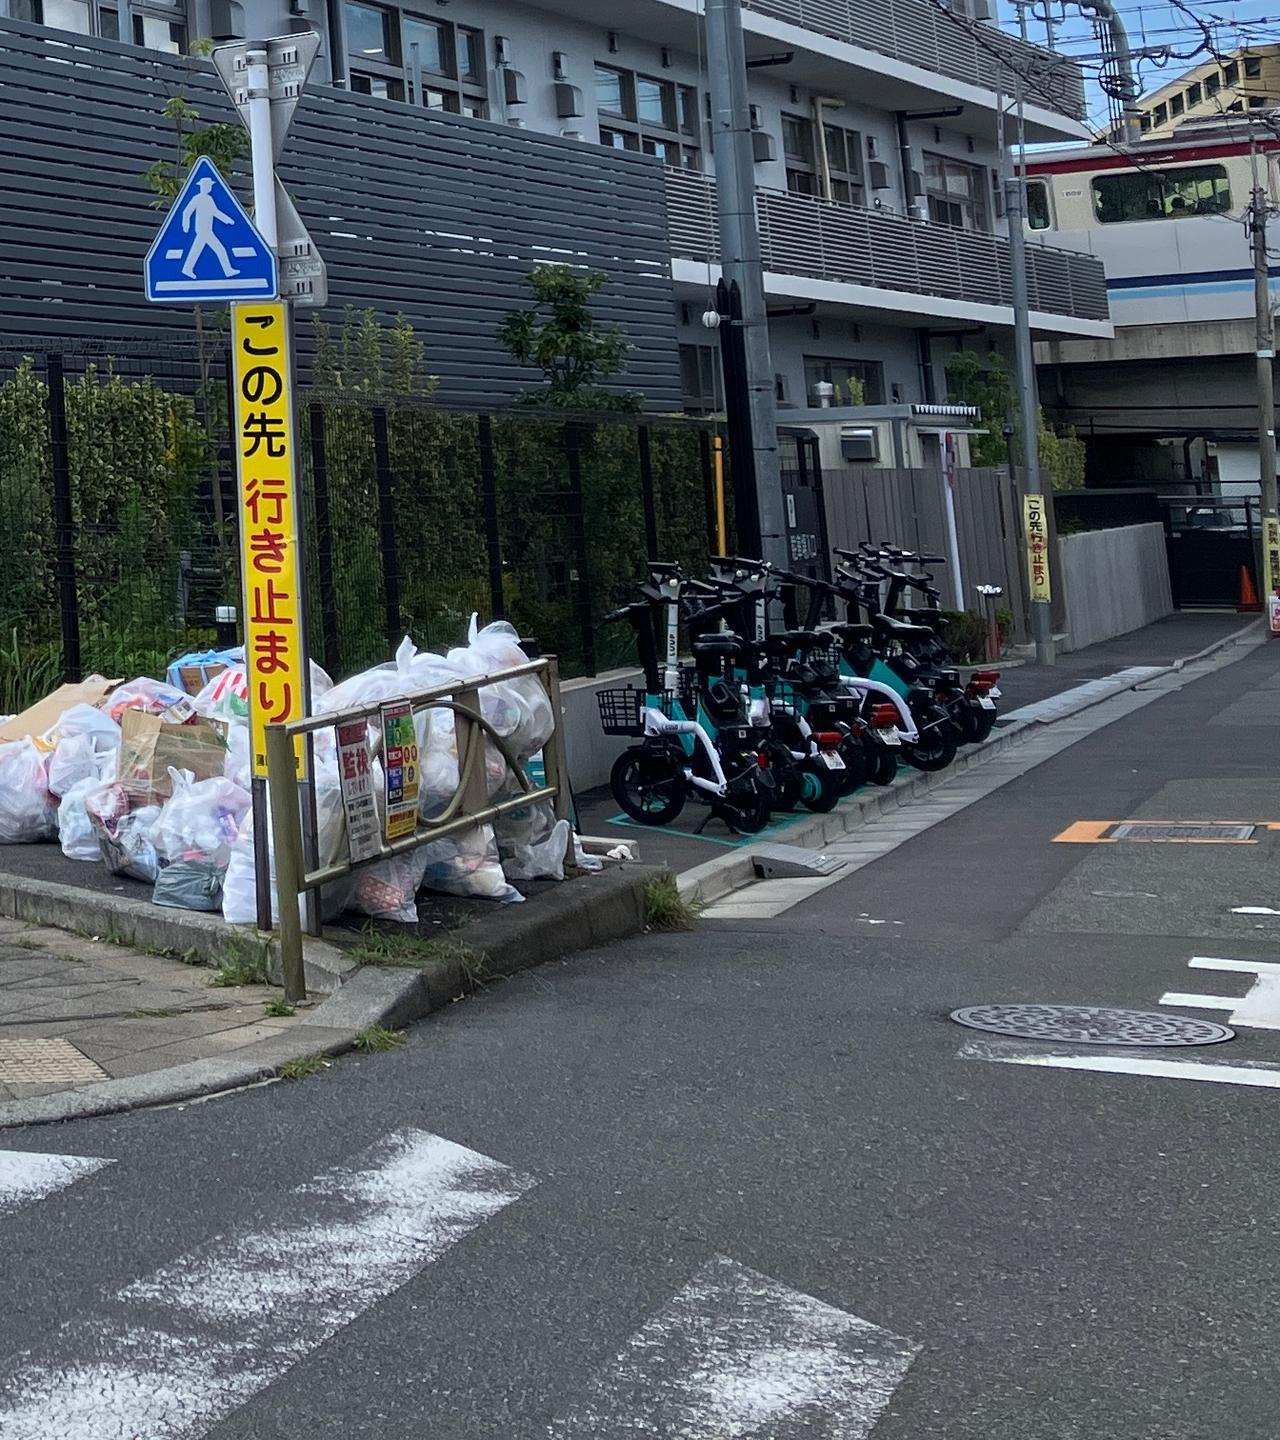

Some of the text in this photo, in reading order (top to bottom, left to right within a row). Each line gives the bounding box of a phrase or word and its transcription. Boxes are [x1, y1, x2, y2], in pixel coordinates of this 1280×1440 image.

[242, 314, 287, 458] この先
[244, 477, 294, 724] 行き止まり
[668, 633, 676, 657] LUUP
